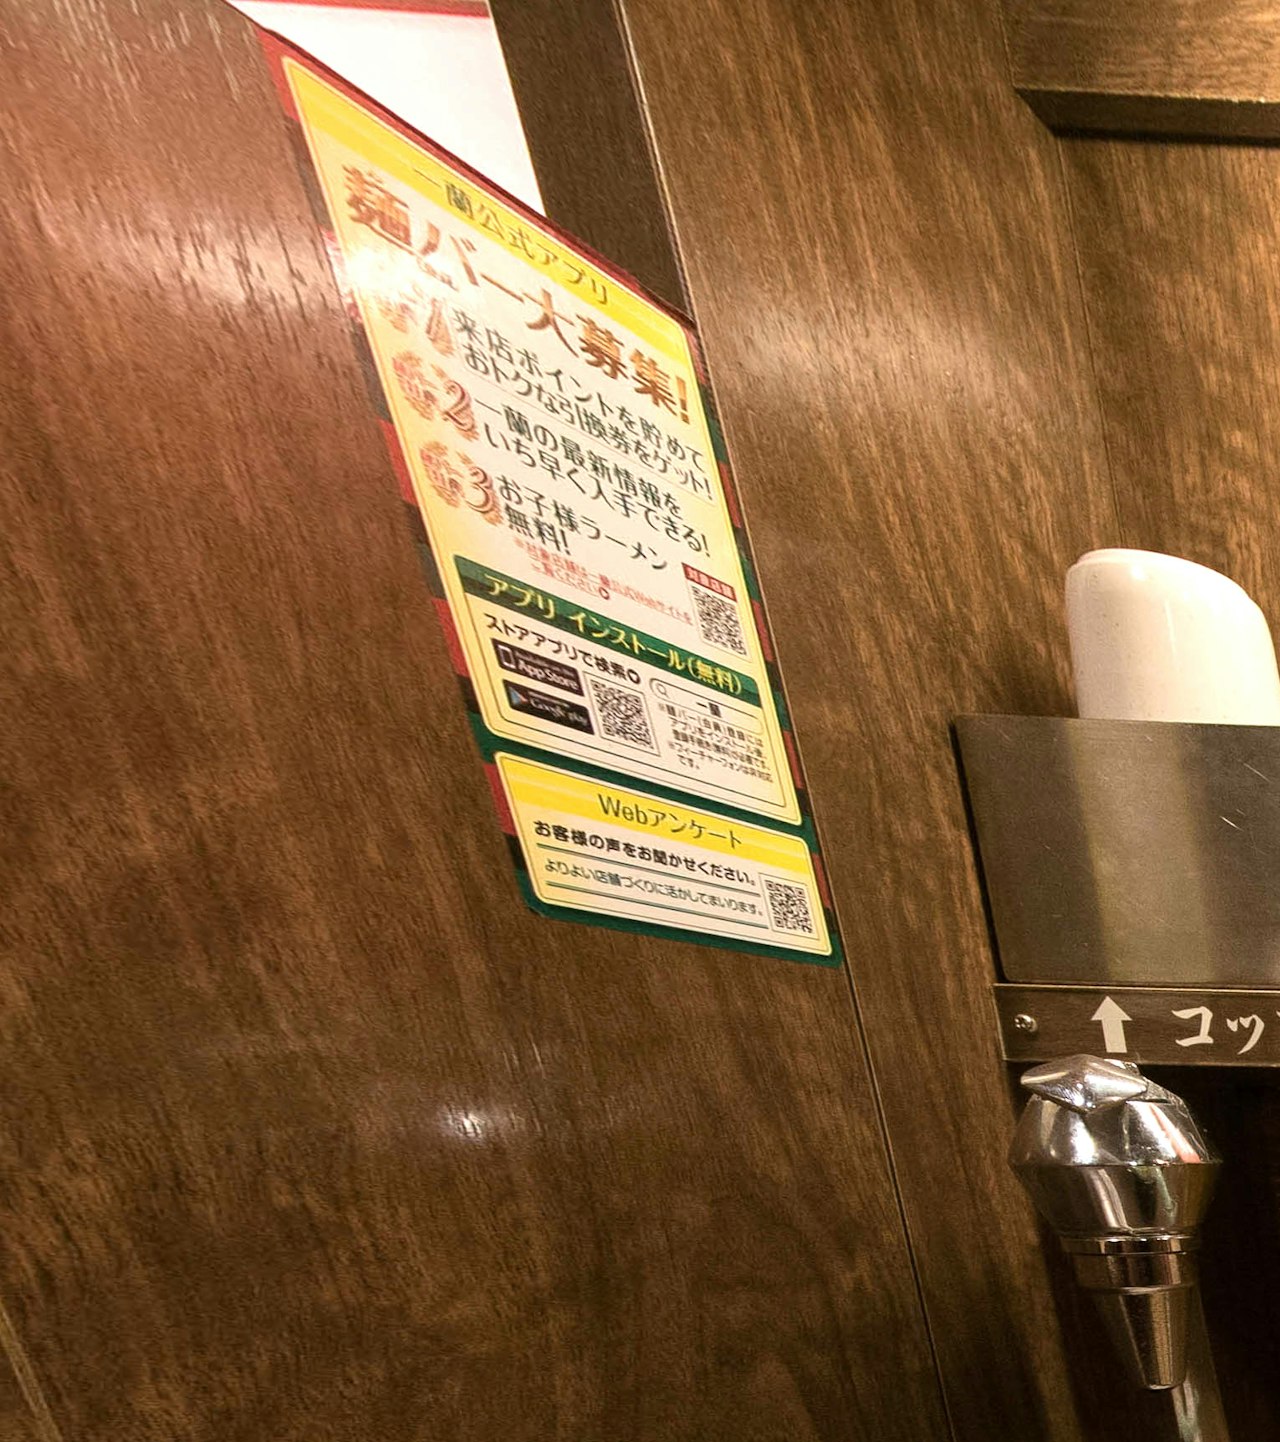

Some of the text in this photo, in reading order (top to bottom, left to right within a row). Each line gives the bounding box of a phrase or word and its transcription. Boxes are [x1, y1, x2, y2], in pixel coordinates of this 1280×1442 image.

[414, 167, 608, 305] 一蘭公式アプリ
[452, 309, 705, 473] 来店ポイントを貯めて
[474, 397, 684, 520] 一蘭の最新情報を
[484, 421, 711, 558] いち早く入手できる!
[499, 475, 668, 569] お子様ラーメン
[504, 505, 571, 554] 無料!
[534, 820, 757, 886] お客様の声をお聞かせください。
[598, 793, 742, 849] Webアンケート
